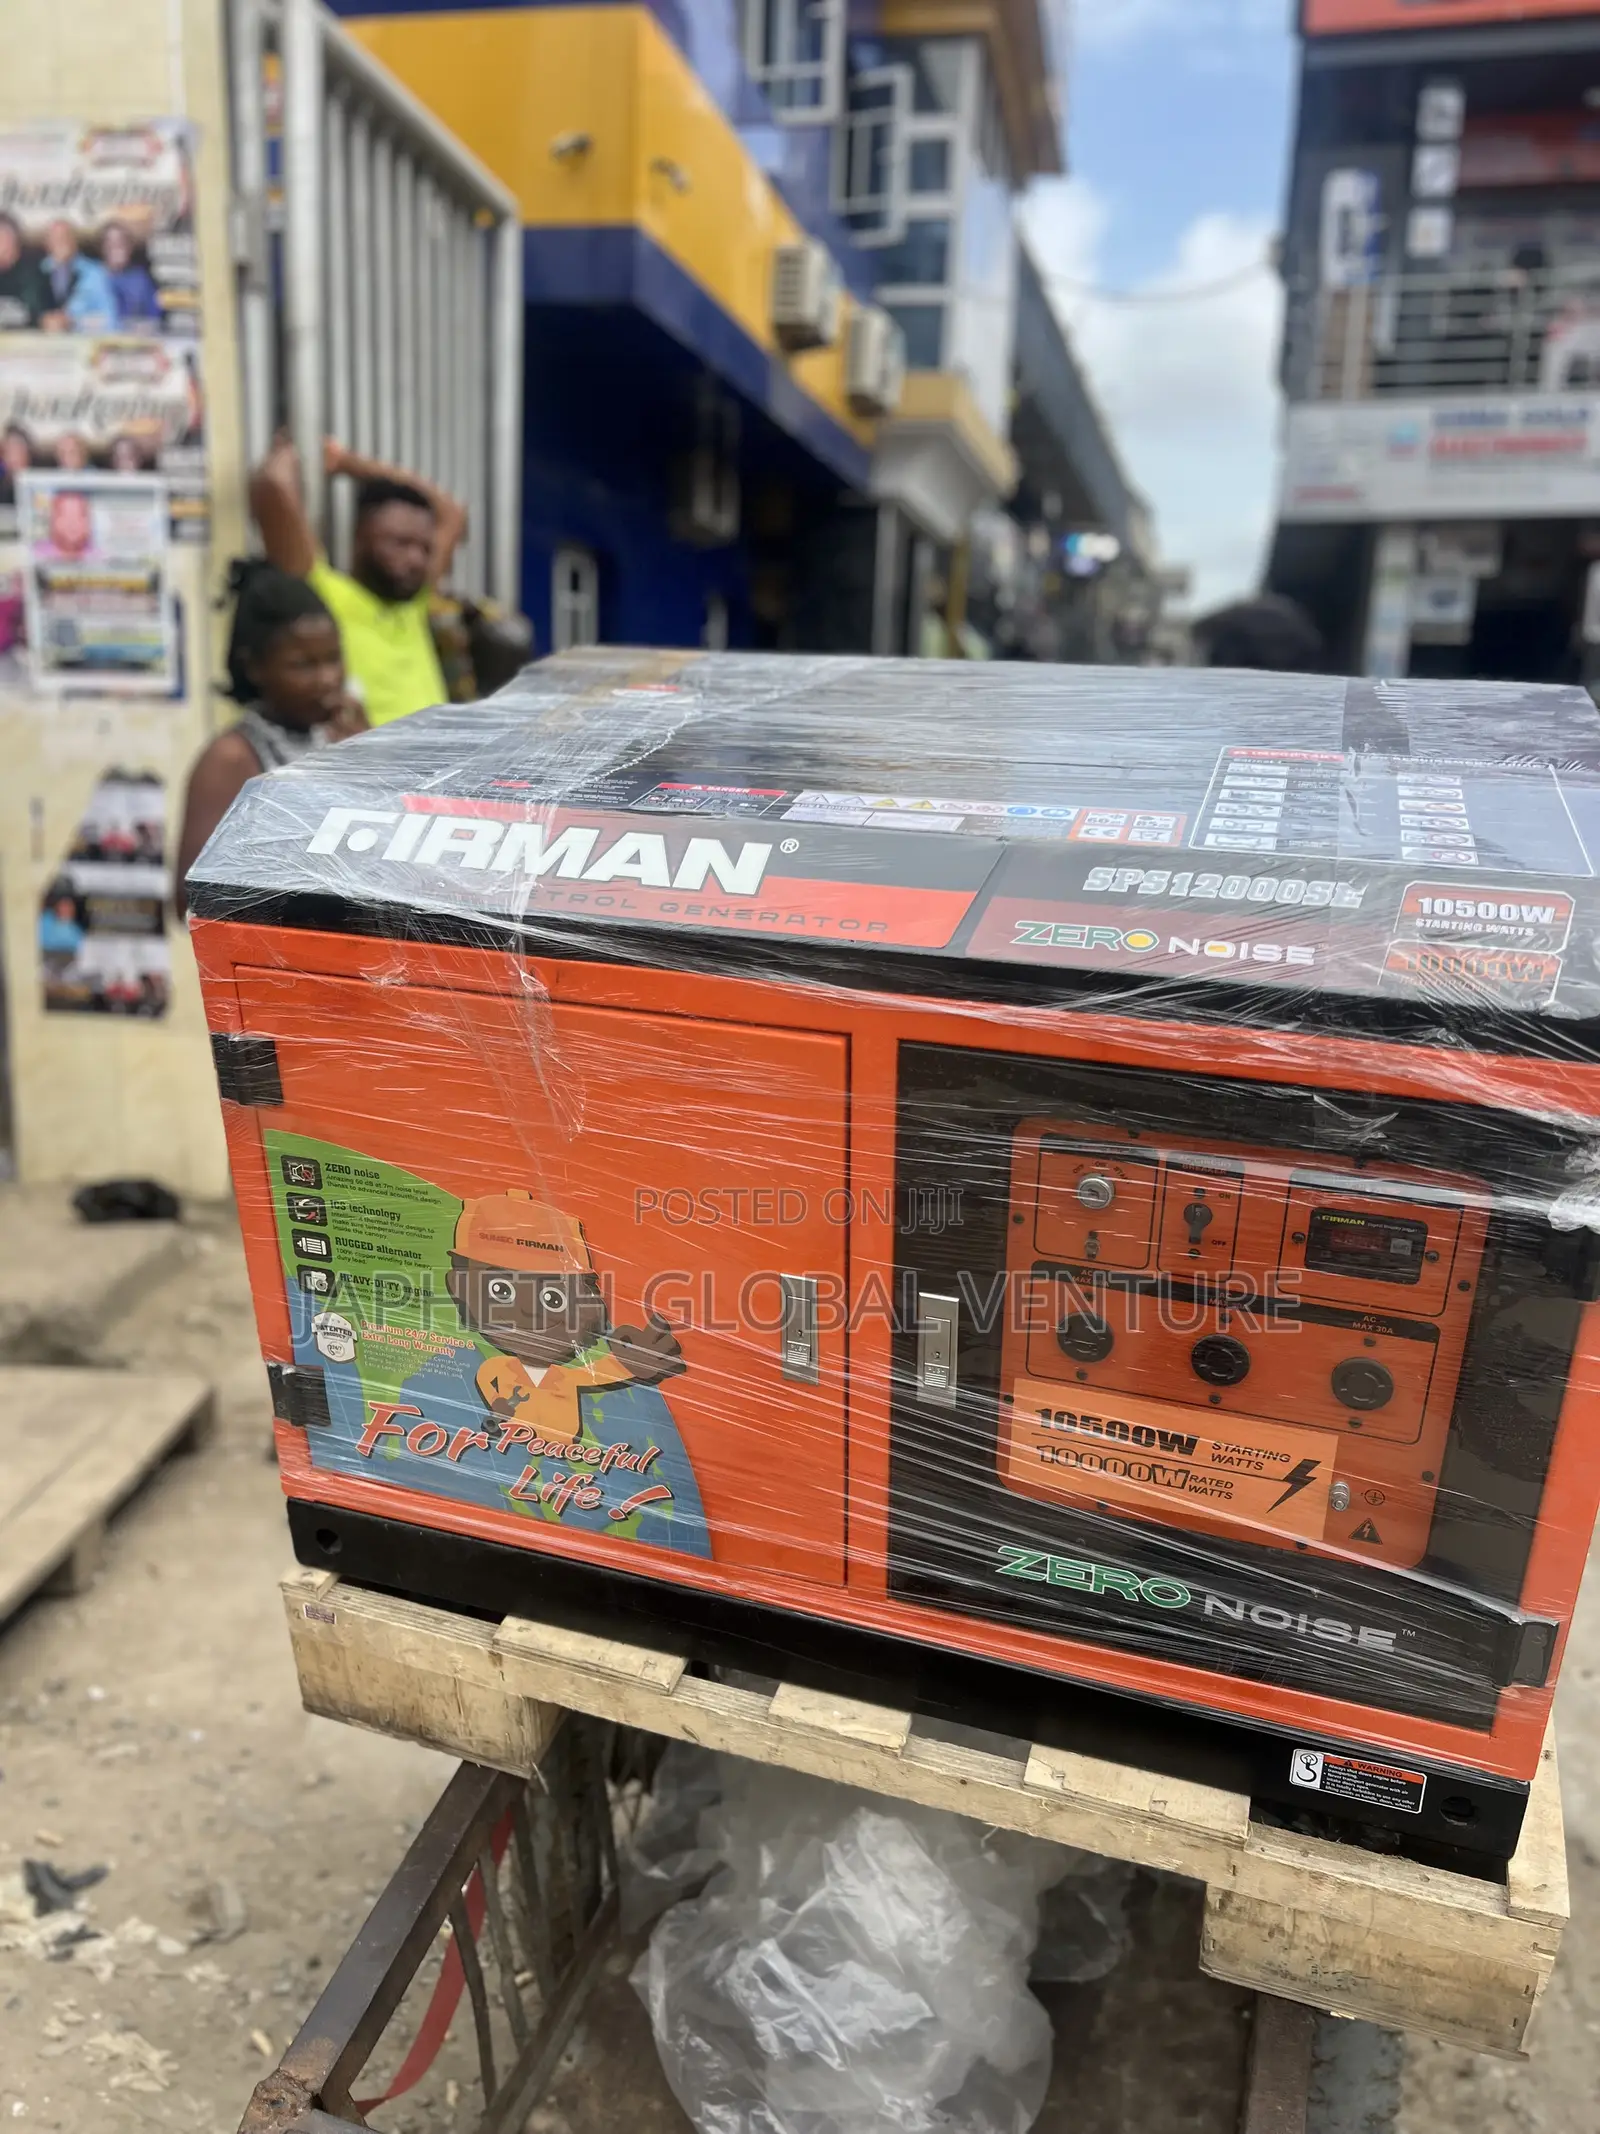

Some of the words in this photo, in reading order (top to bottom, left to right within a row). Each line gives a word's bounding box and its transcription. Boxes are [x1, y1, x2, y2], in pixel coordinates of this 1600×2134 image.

[306, 807, 774, 896] FIRMAN
[1082, 866, 1370, 909] SPS12000SE
[659, 901, 889, 935] GENERATOR
[1417, 897, 1556, 924] 10500W
[1415, 918, 1483, 933] STARTING
[1485, 923, 1535, 937] WATTS
[1009, 920, 1160, 953] ZERO
[1167, 936, 1316, 966] NOISE
[324, 1162, 351, 1175] ZERO
[354, 1167, 380, 1179] noise
[348, 1204, 401, 1222] technology
[1321, 1214, 1365, 1226] FIRMAN
[335, 1236, 374, 1251] RUGGED
[376, 1244, 423, 1260] alternator
[515, 1238, 565, 1253] FIRMAN
[339, 1272, 400, 1292] HEAVY-DUTY
[315, 1324, 353, 1337] PATENTED
[1352, 1321, 1373, 1331] MAX
[1375, 1325, 1394, 1334] 30A
[1363, 1315, 1377, 1323] AC
[361, 1319, 404, 1336] Premium
[404, 1327, 427, 1341] 24/7
[429, 1332, 465, 1348] Service
[361, 1330, 386, 1343] Extra
[387, 1334, 412, 1350] Long
[412, 1340, 456, 1359] Warranty
[354, 1400, 491, 1462] For
[1034, 1408, 1200, 1457] 10500W
[1211, 1440, 1291, 1463] STARTING
[495, 1420, 664, 1475] Peaceful
[1036, 1445, 1191, 1490] 10000W
[1188, 1474, 1235, 1490] RATED
[1210, 1453, 1265, 1472] WATTS
[1187, 1483, 1234, 1501] WATTS
[993, 1545, 1192, 1609] ZERO
[1203, 1594, 1398, 1654] NOISE
[1357, 1761, 1403, 1778] WARNING
